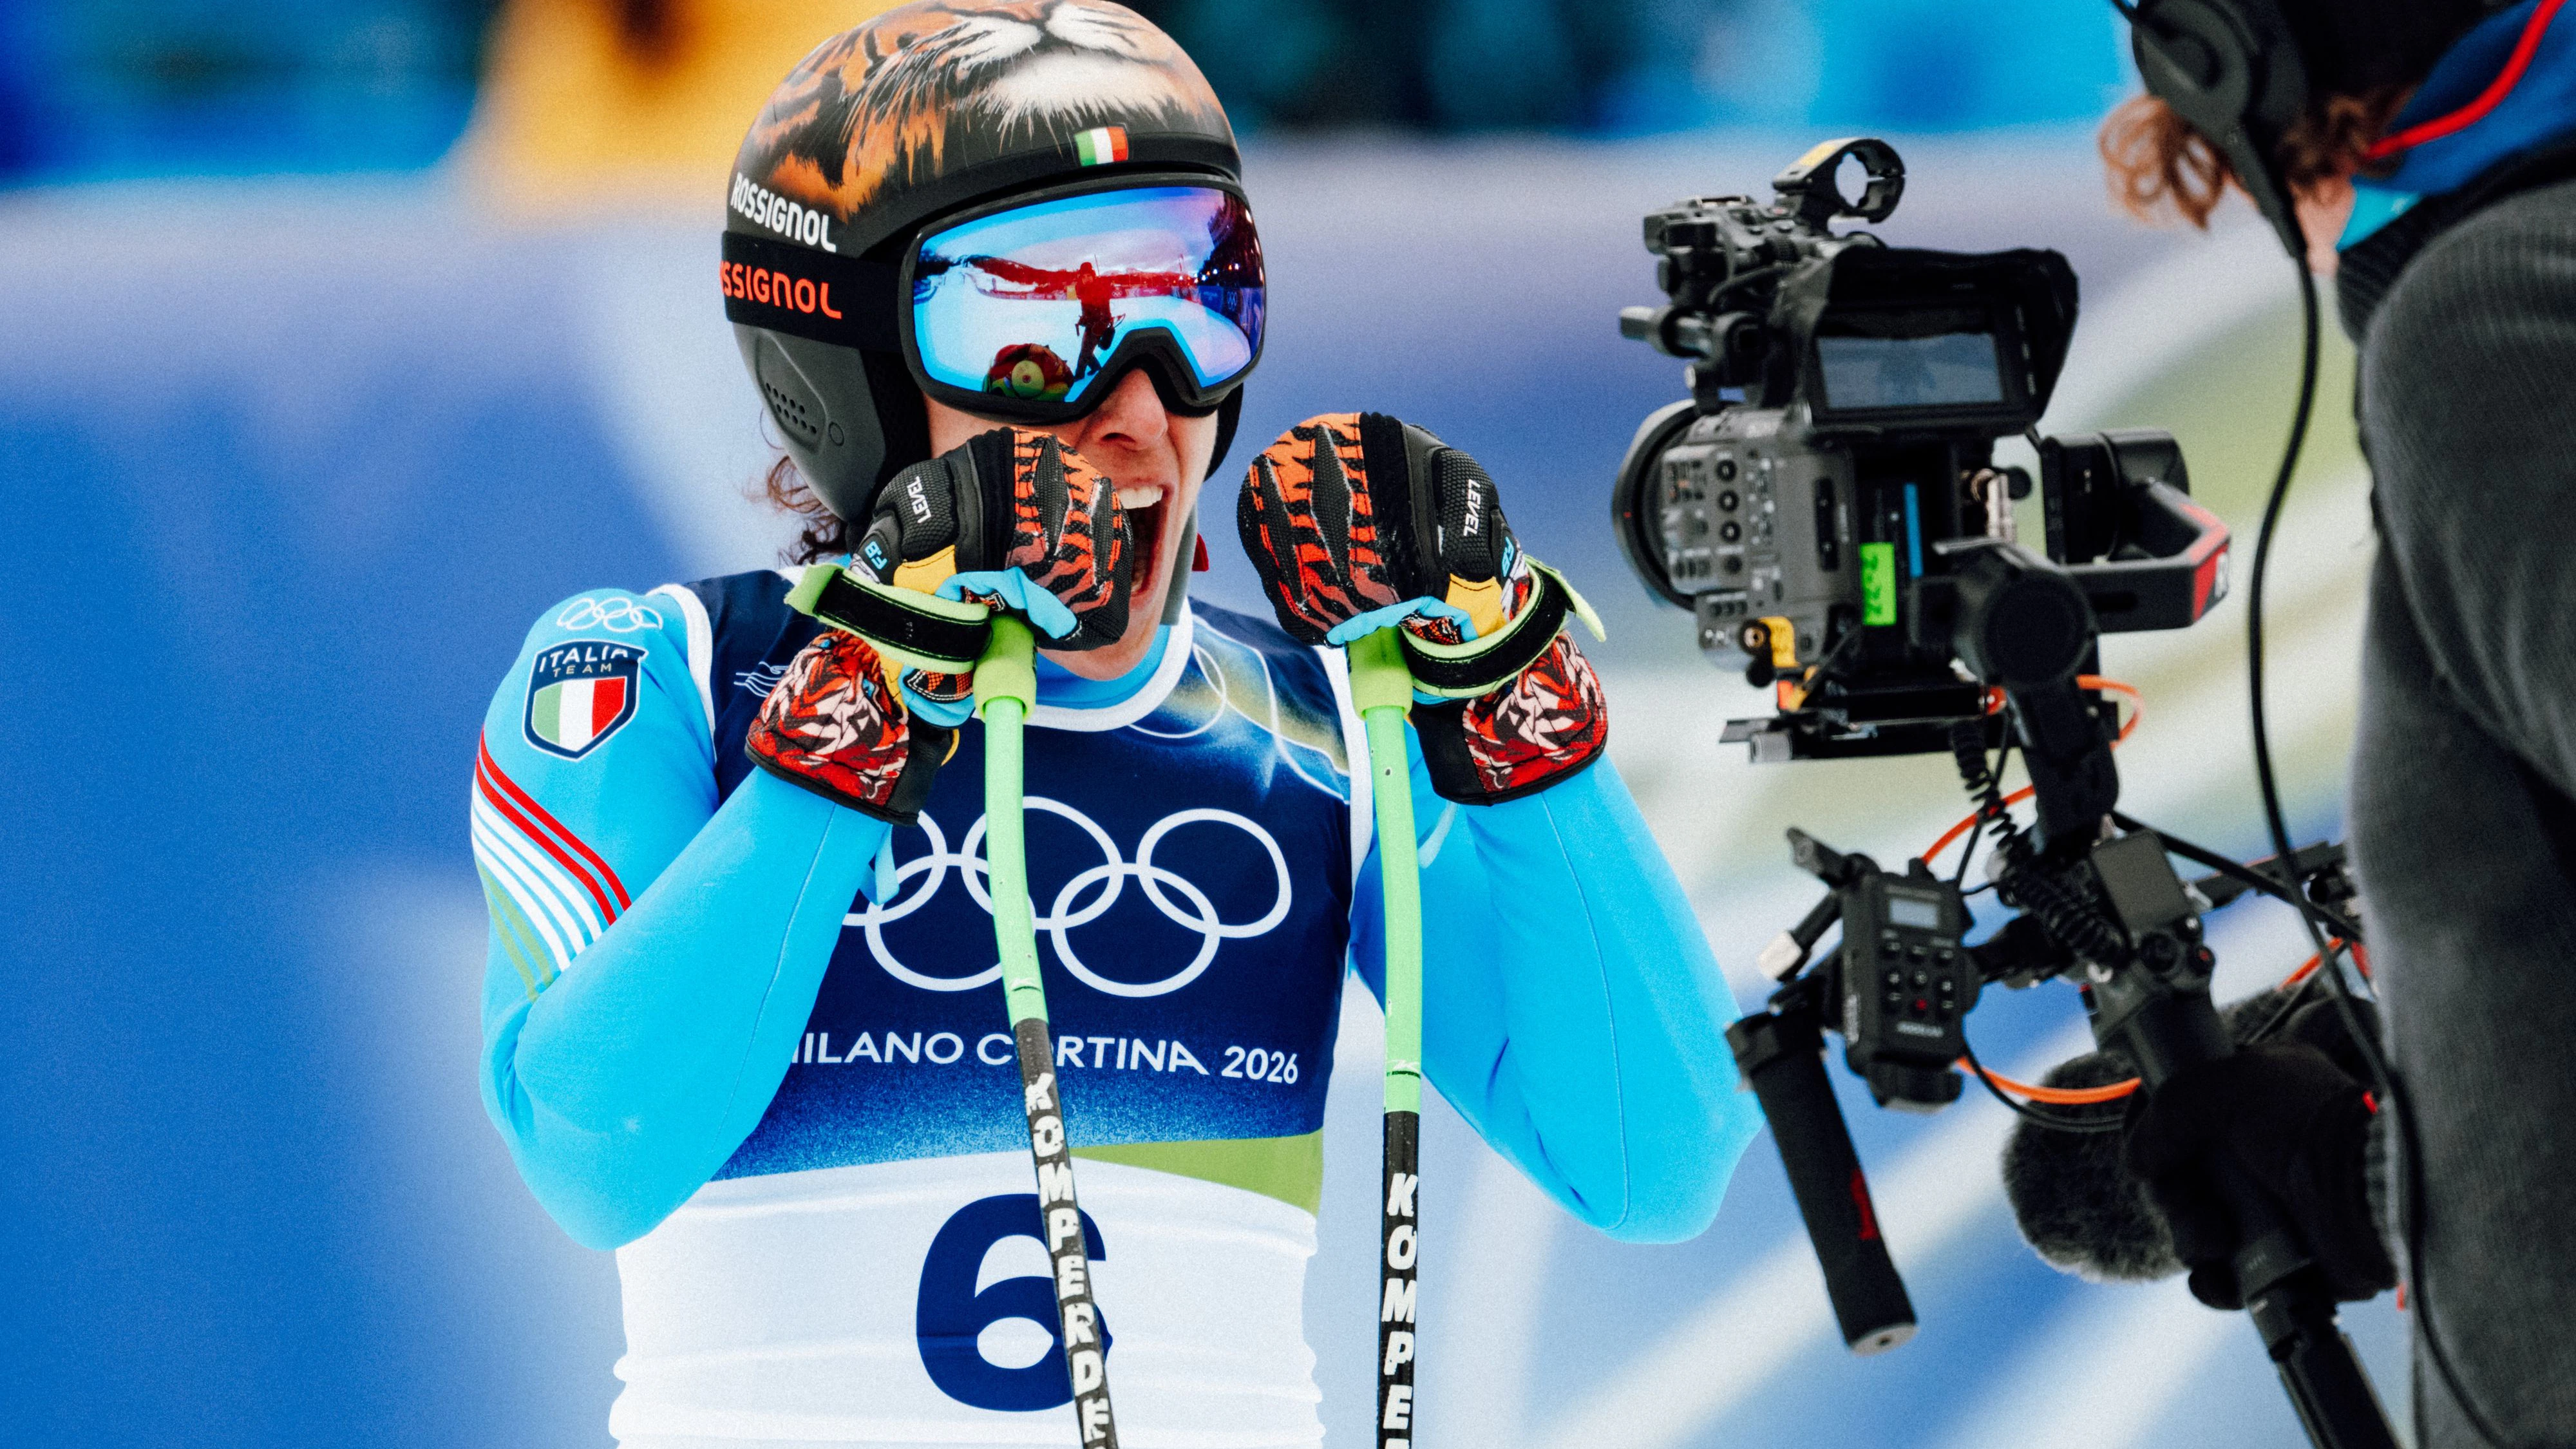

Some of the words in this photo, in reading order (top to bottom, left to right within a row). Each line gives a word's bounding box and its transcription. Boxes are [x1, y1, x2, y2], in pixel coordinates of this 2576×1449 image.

[730, 172, 837, 252] ROSSIGNOL
[719, 260, 842, 319] SSIGNOL
[907, 475, 932, 524] LEVEL
[1463, 479, 1481, 536] LEVEL
[553, 663, 612, 677] TEAM
[976, 1033, 1210, 1075] CRTINA
[1221, 1045, 1298, 1084] 2026
[1025, 1072, 1110, 1449] KOMPERDE
[916, 1193, 1113, 1412] 6
[1381, 1172, 1418, 1449] KOMPE
